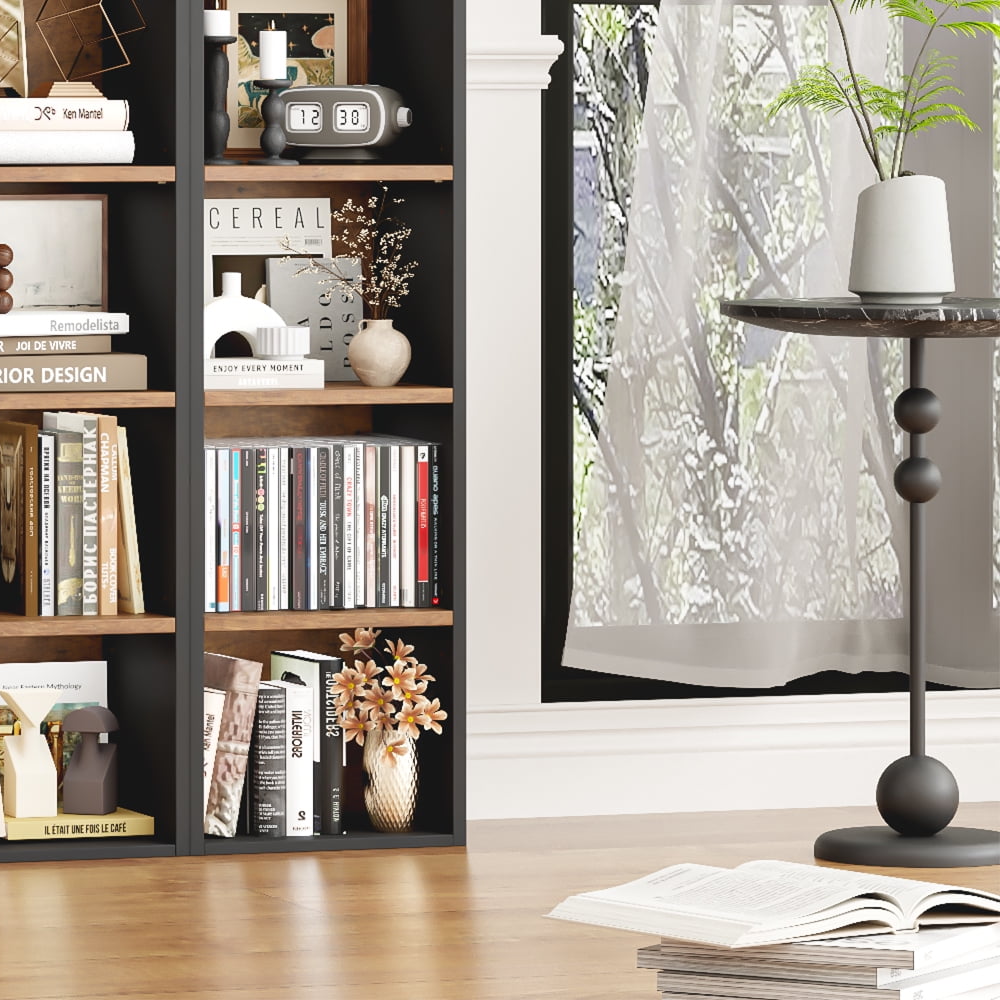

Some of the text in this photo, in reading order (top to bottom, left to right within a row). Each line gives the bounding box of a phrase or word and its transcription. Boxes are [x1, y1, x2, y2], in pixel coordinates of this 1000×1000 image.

[62, 107, 104, 119] Ken Mantel
[301, 109, 320, 126] 12
[340, 109, 360, 126] 30
[209, 206, 325, 230] CEREAL
[49, 318, 120, 332] Remodelista
[16, 340, 31, 351] JOI
[34, 340, 47, 351] DE
[50, 339, 77, 350] VIVRE
[41, 366, 107, 384] DESIGN
[213, 363, 304, 373] ENJOY EVERY MOMENT
[100, 432, 110, 493] CHAPMAN
[43, 473, 50, 482] НА
[83, 426, 98, 604] БОРИС ПАСТЕРНАК
[109, 547, 118, 604] BOOK COVER
[46, 682, 82, 690] Mythology
[44, 821, 127, 835] IL ÉTAIT UNE FOIS LE CAFÉ
